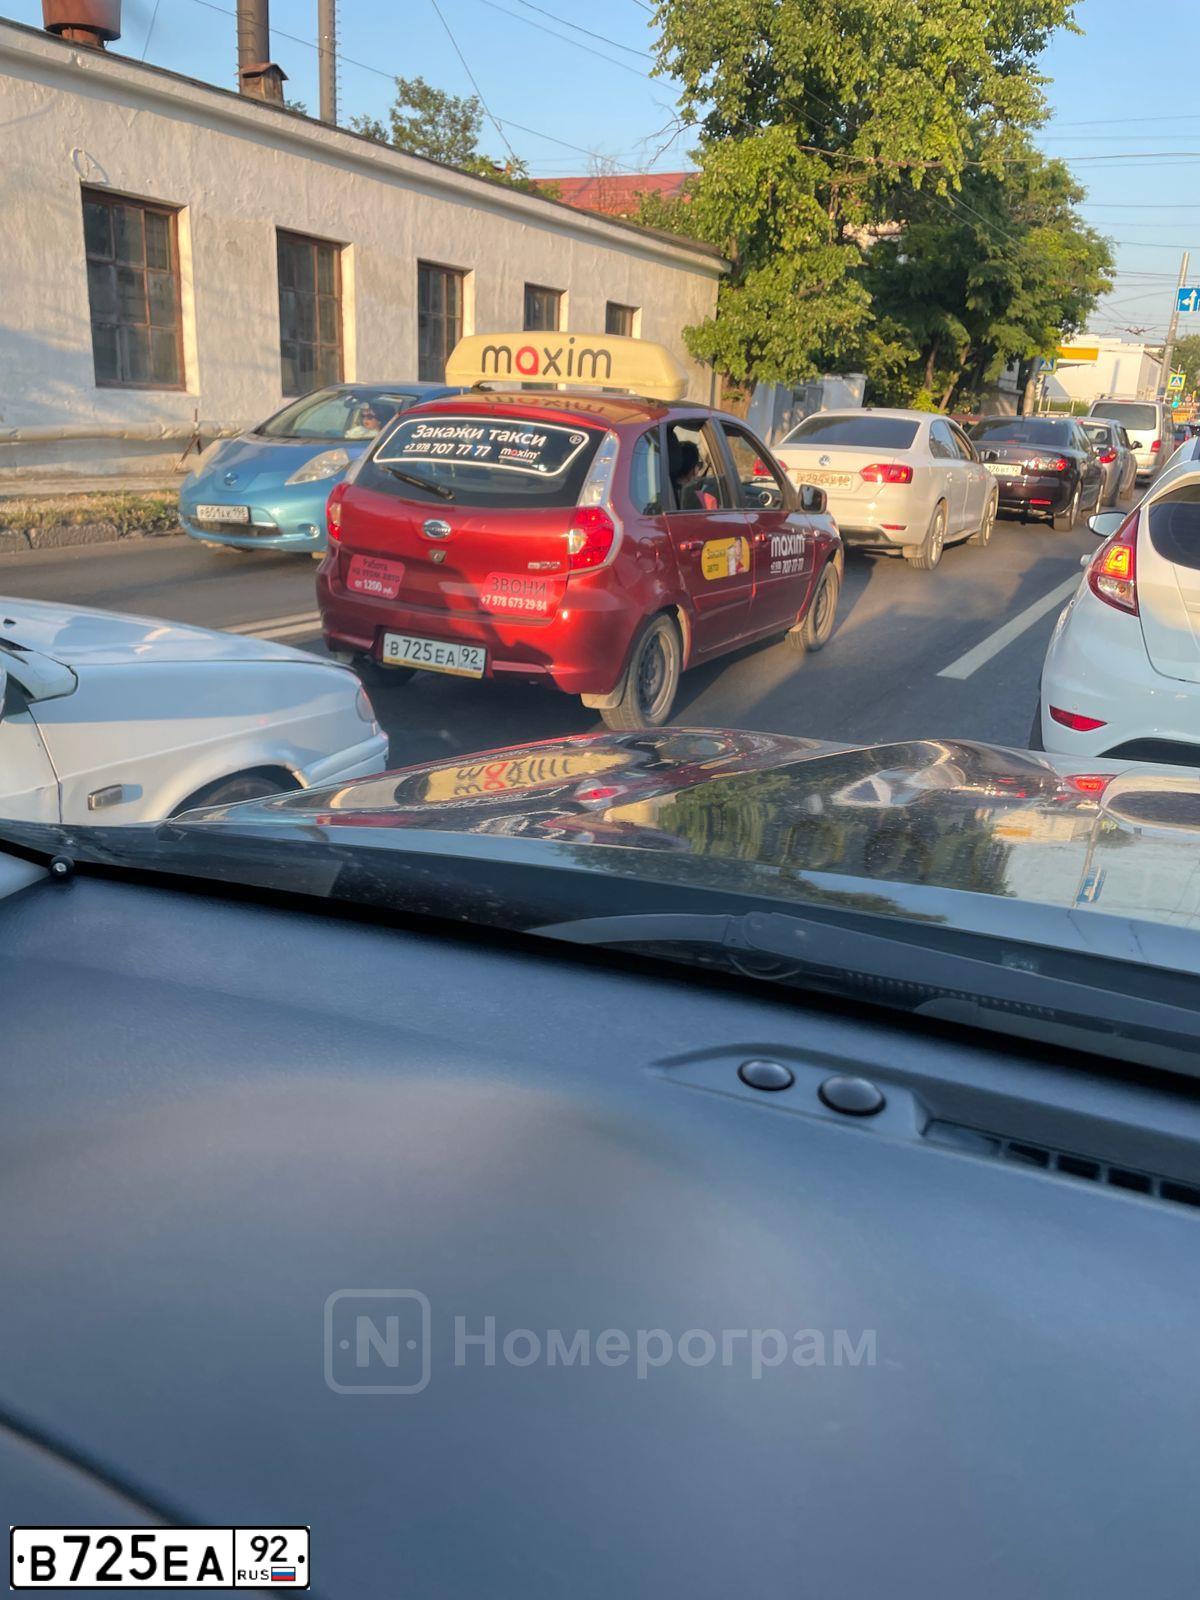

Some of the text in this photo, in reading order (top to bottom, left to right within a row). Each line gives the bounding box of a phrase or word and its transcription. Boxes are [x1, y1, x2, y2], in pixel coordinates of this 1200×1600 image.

[481, 337, 612, 379] maxim
[411, 424, 547, 446] Закажи такси
[430, 443, 455, 454] 707
[455, 444, 473, 455] 77
[474, 445, 492, 457] 77
[500, 447, 540, 460] maxim
[770, 534, 806, 558] maxim
[491, 576, 546, 596] ЗВОНИ
[481, 594, 491, 605] +7
[492, 595, 507, 607] 978
[461, 648, 479, 664] 92
